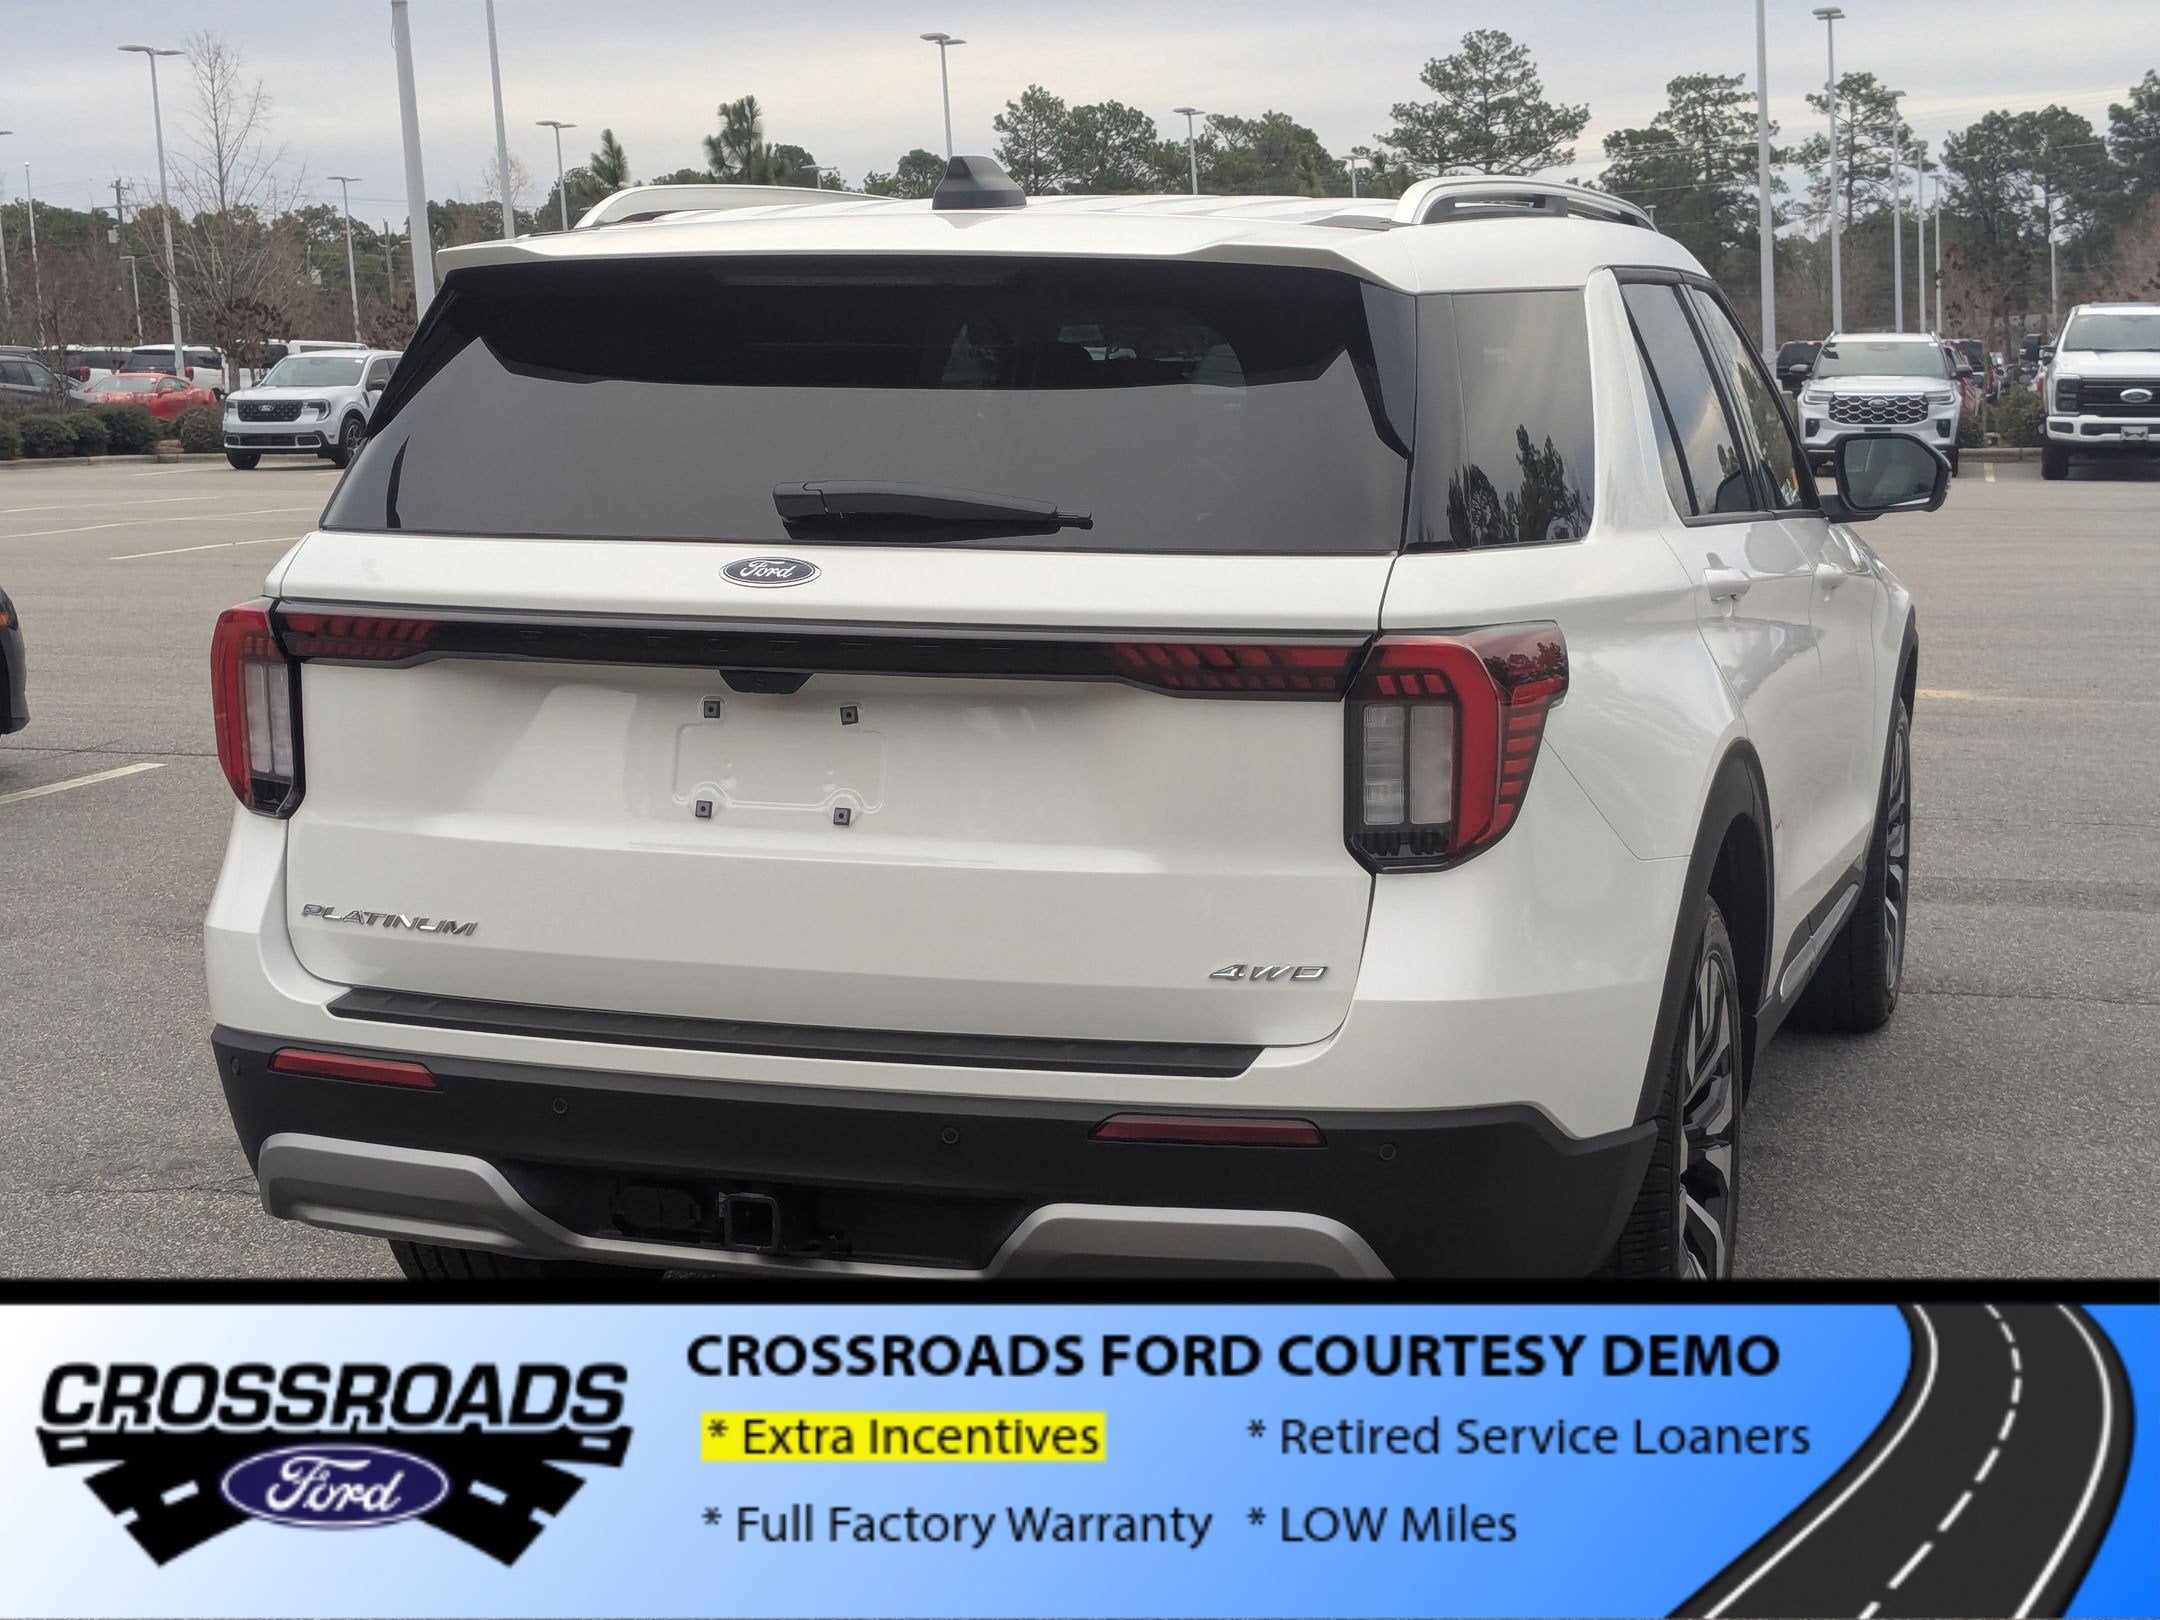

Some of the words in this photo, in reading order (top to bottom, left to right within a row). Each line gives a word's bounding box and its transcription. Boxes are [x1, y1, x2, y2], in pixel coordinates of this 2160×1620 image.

[739, 560, 797, 578] Ford
[302, 904, 478, 937] PLATINUM
[1208, 964, 1329, 982] 4WD
